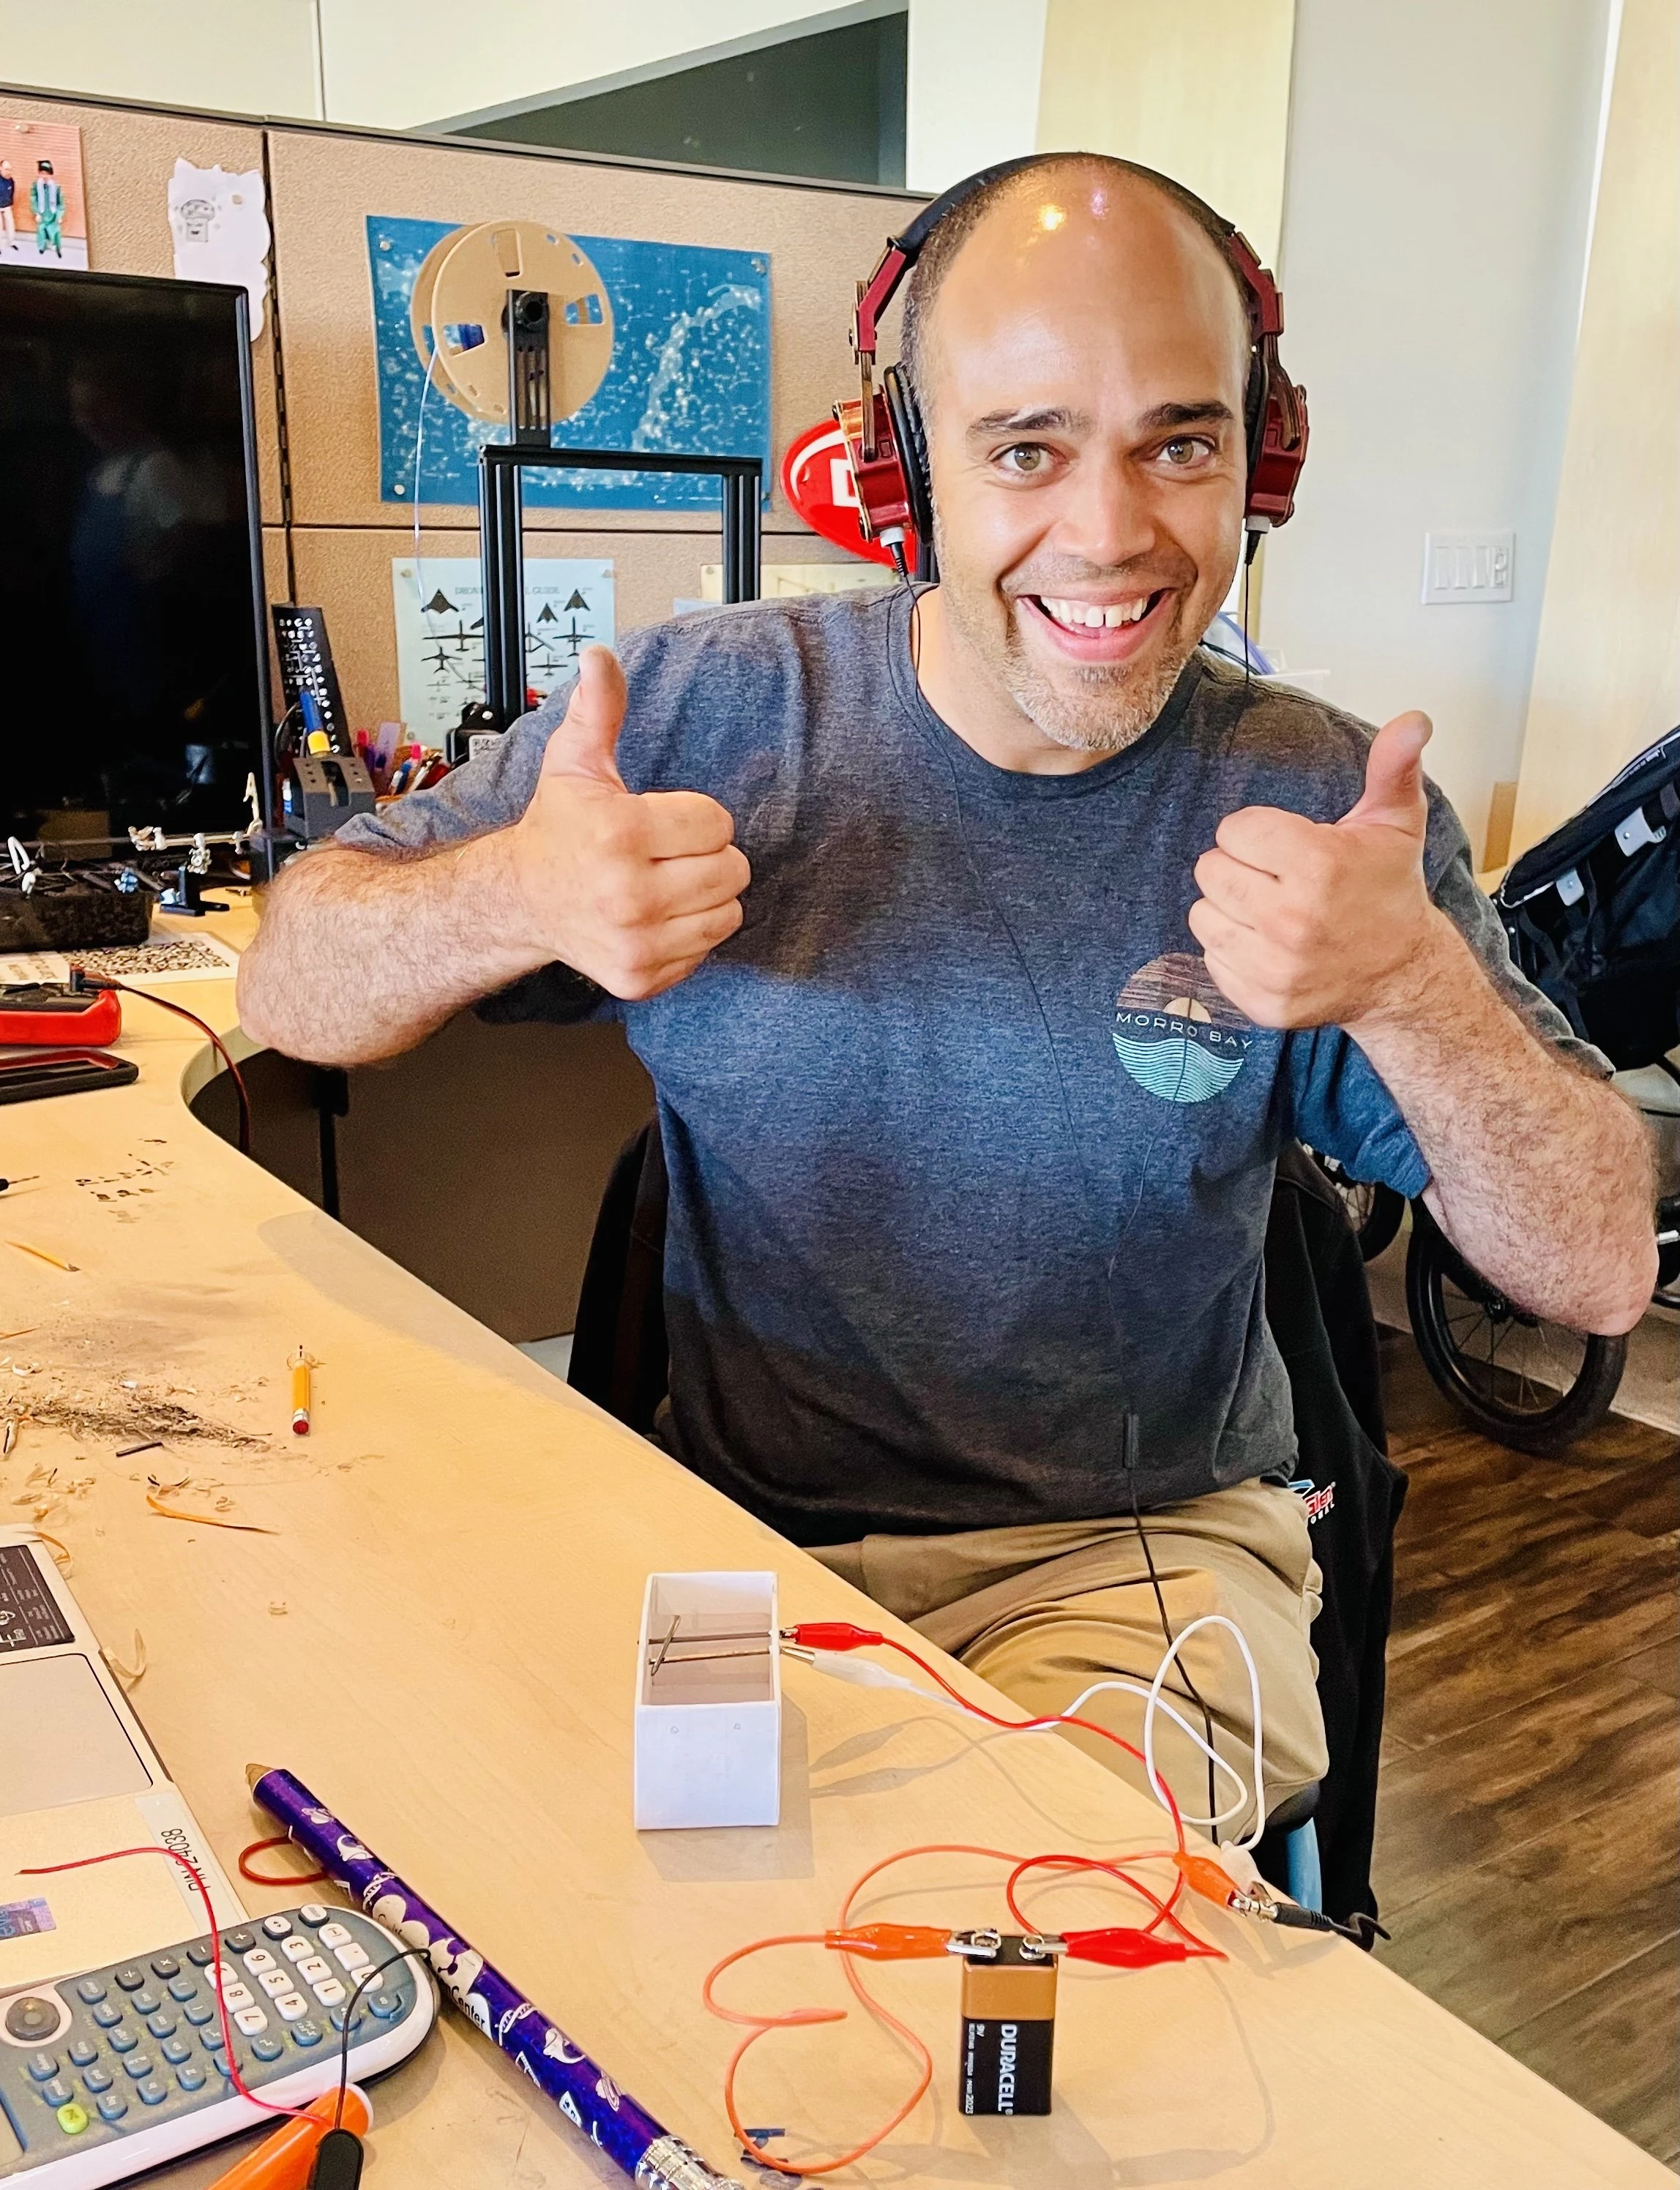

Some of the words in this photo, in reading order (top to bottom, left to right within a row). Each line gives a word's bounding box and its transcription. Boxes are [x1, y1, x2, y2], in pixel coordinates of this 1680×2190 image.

[1116, 1013, 1198, 1037] MORRO
[1209, 1031, 1252, 1049] BAY
[161, 1828, 198, 1866] 24038
[289, 1941, 304, 1949] 3
[250, 1954, 266, 1962] 6
[307, 1962, 321, 1970] 2
[269, 1976, 284, 1984] 5
[229, 1989, 243, 1997] 8
[324, 1985, 337, 1994] 1
[285, 1998, 299, 2007] 4
[244, 2014, 260, 2022] 7
[998, 2024, 1018, 2112] DURACELL
